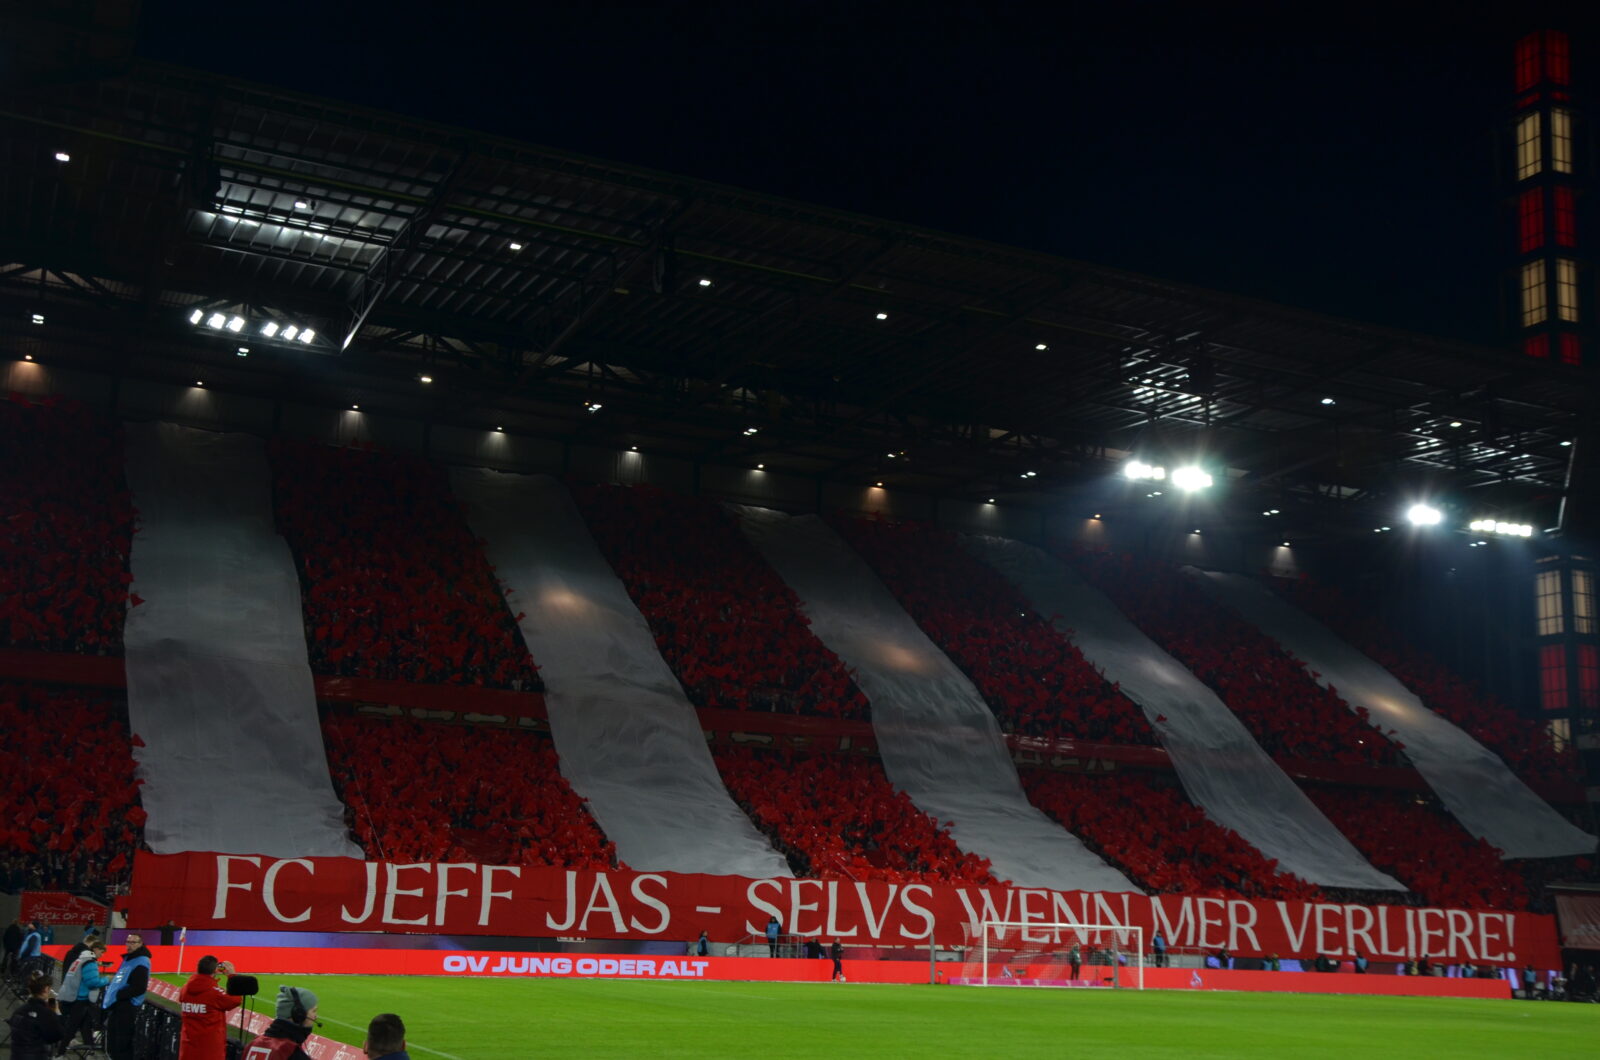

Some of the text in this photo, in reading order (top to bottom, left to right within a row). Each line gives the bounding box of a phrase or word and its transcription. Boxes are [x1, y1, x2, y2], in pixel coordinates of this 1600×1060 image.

[213, 855, 315, 923] FC
[341, 861, 521, 927] JEFF
[546, 870, 671, 935] JAS
[746, 879, 934, 940] SELVS
[956, 887, 1130, 946] WENN
[1150, 895, 1262, 952] MER
[1276, 900, 1517, 962] VERLIERE!
[442, 955, 710, 978] OV JUNG ODER ALT
